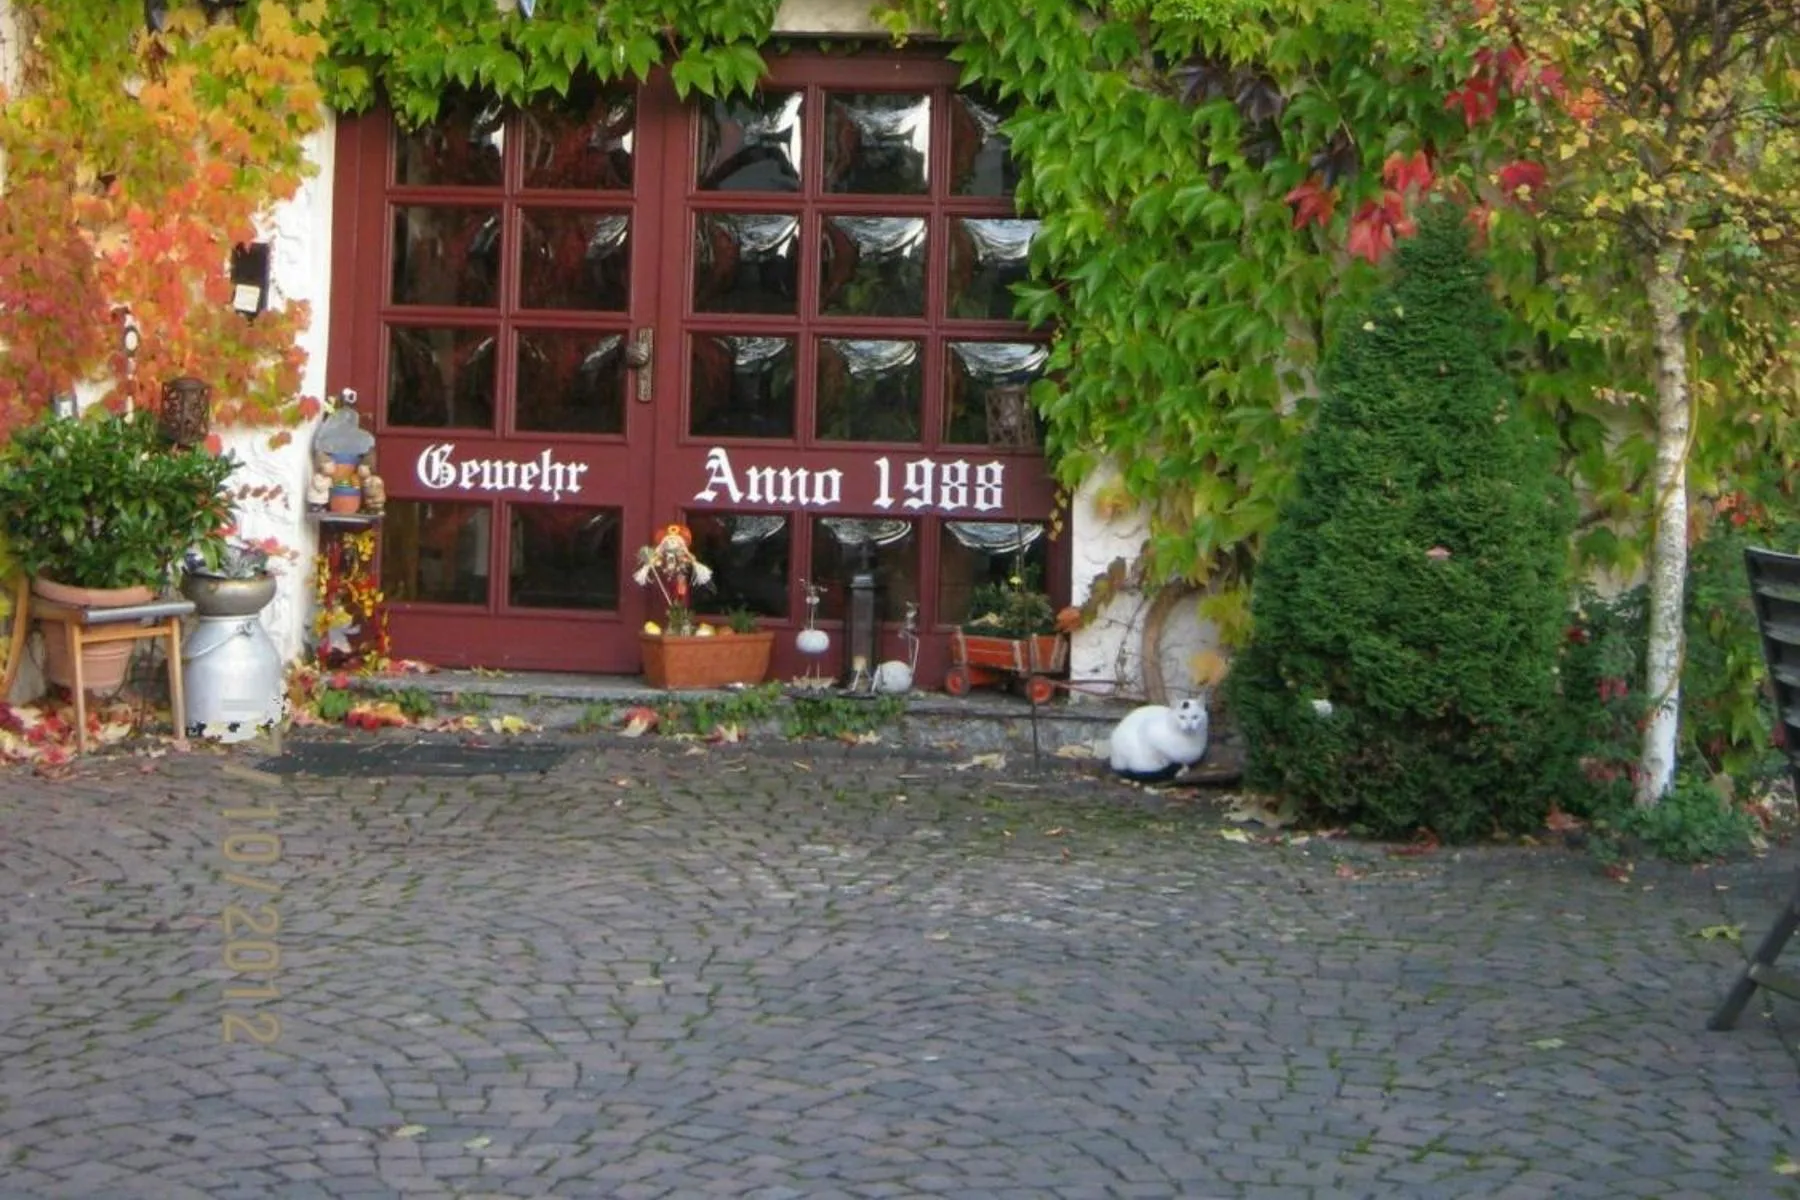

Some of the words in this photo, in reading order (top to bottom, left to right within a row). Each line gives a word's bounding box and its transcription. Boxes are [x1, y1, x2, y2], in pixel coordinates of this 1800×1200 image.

[415, 443, 589, 502] Gewehr
[694, 447, 843, 507] Anno
[873, 457, 1006, 511] 1988
